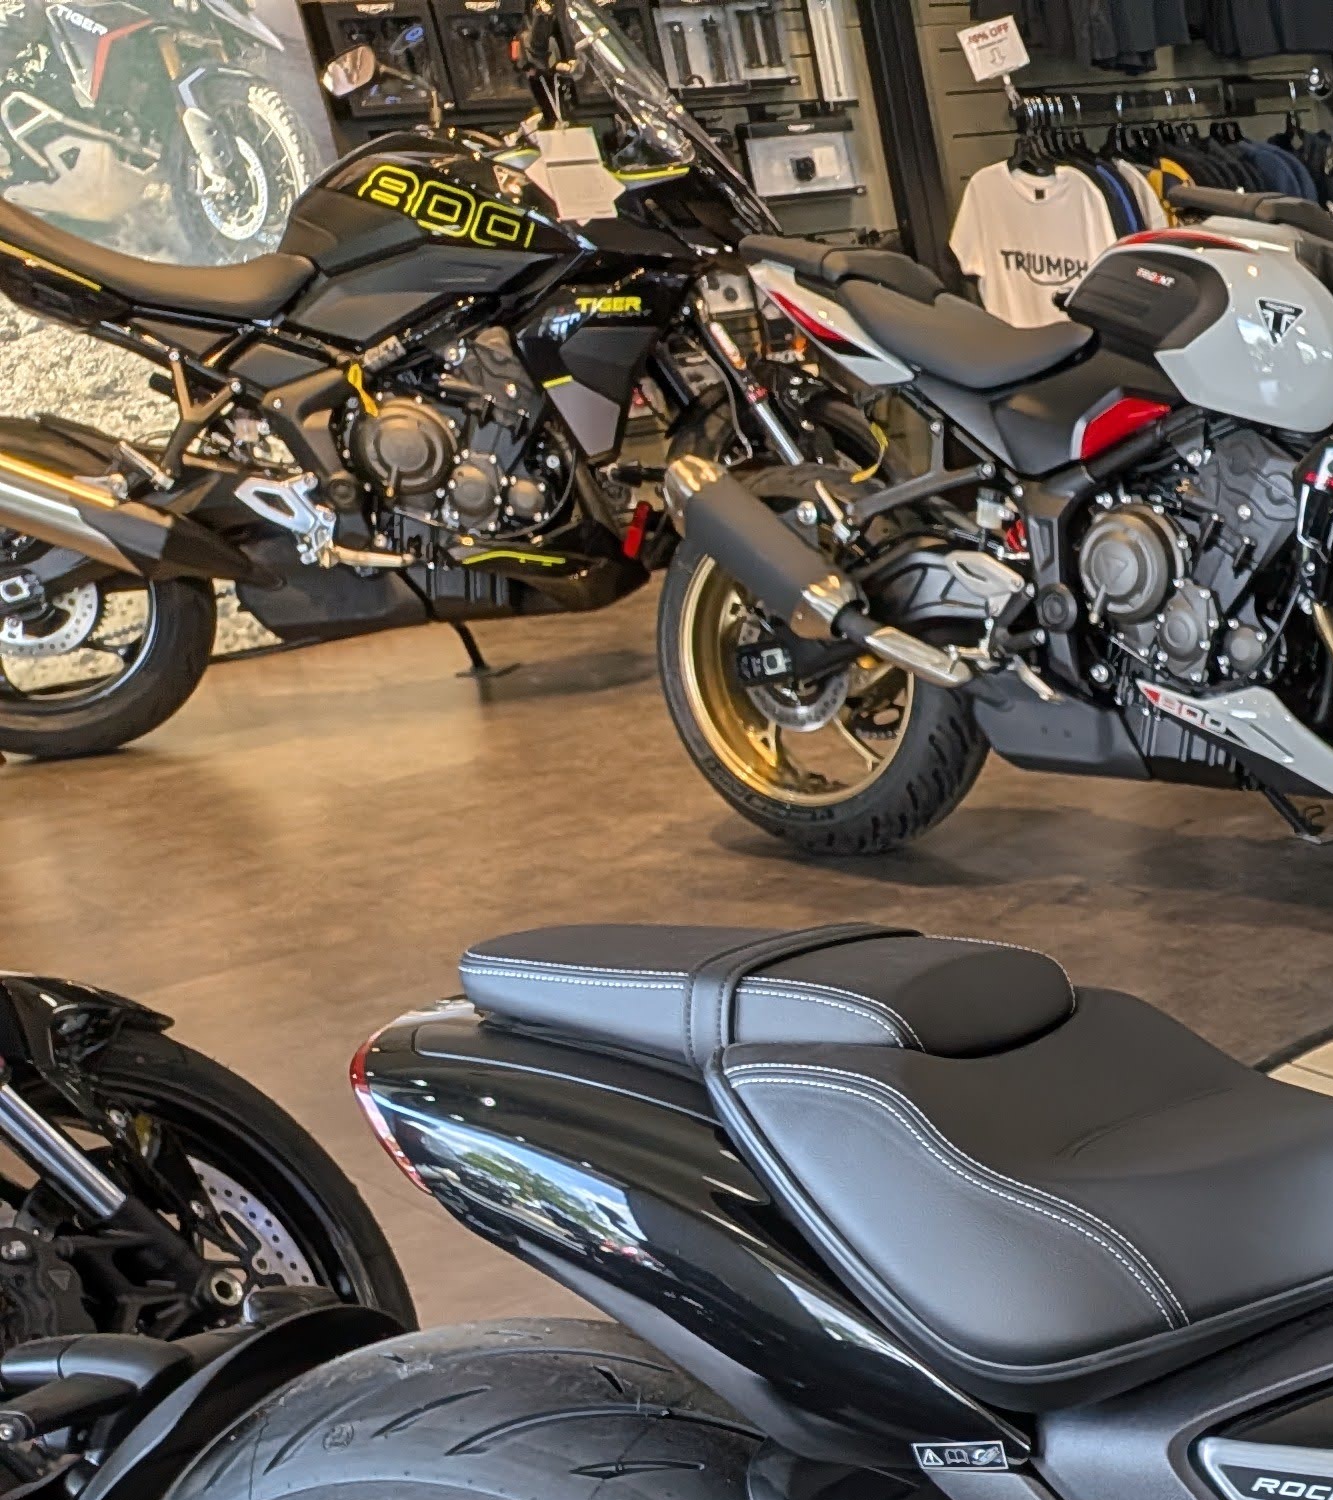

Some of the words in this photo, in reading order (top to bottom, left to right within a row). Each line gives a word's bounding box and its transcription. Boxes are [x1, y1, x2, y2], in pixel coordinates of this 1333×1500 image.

[56, 4, 108, 36] TIGER
[1000, 250, 1089, 281] TRIUMPH
[575, 296, 641, 313] TIGER
